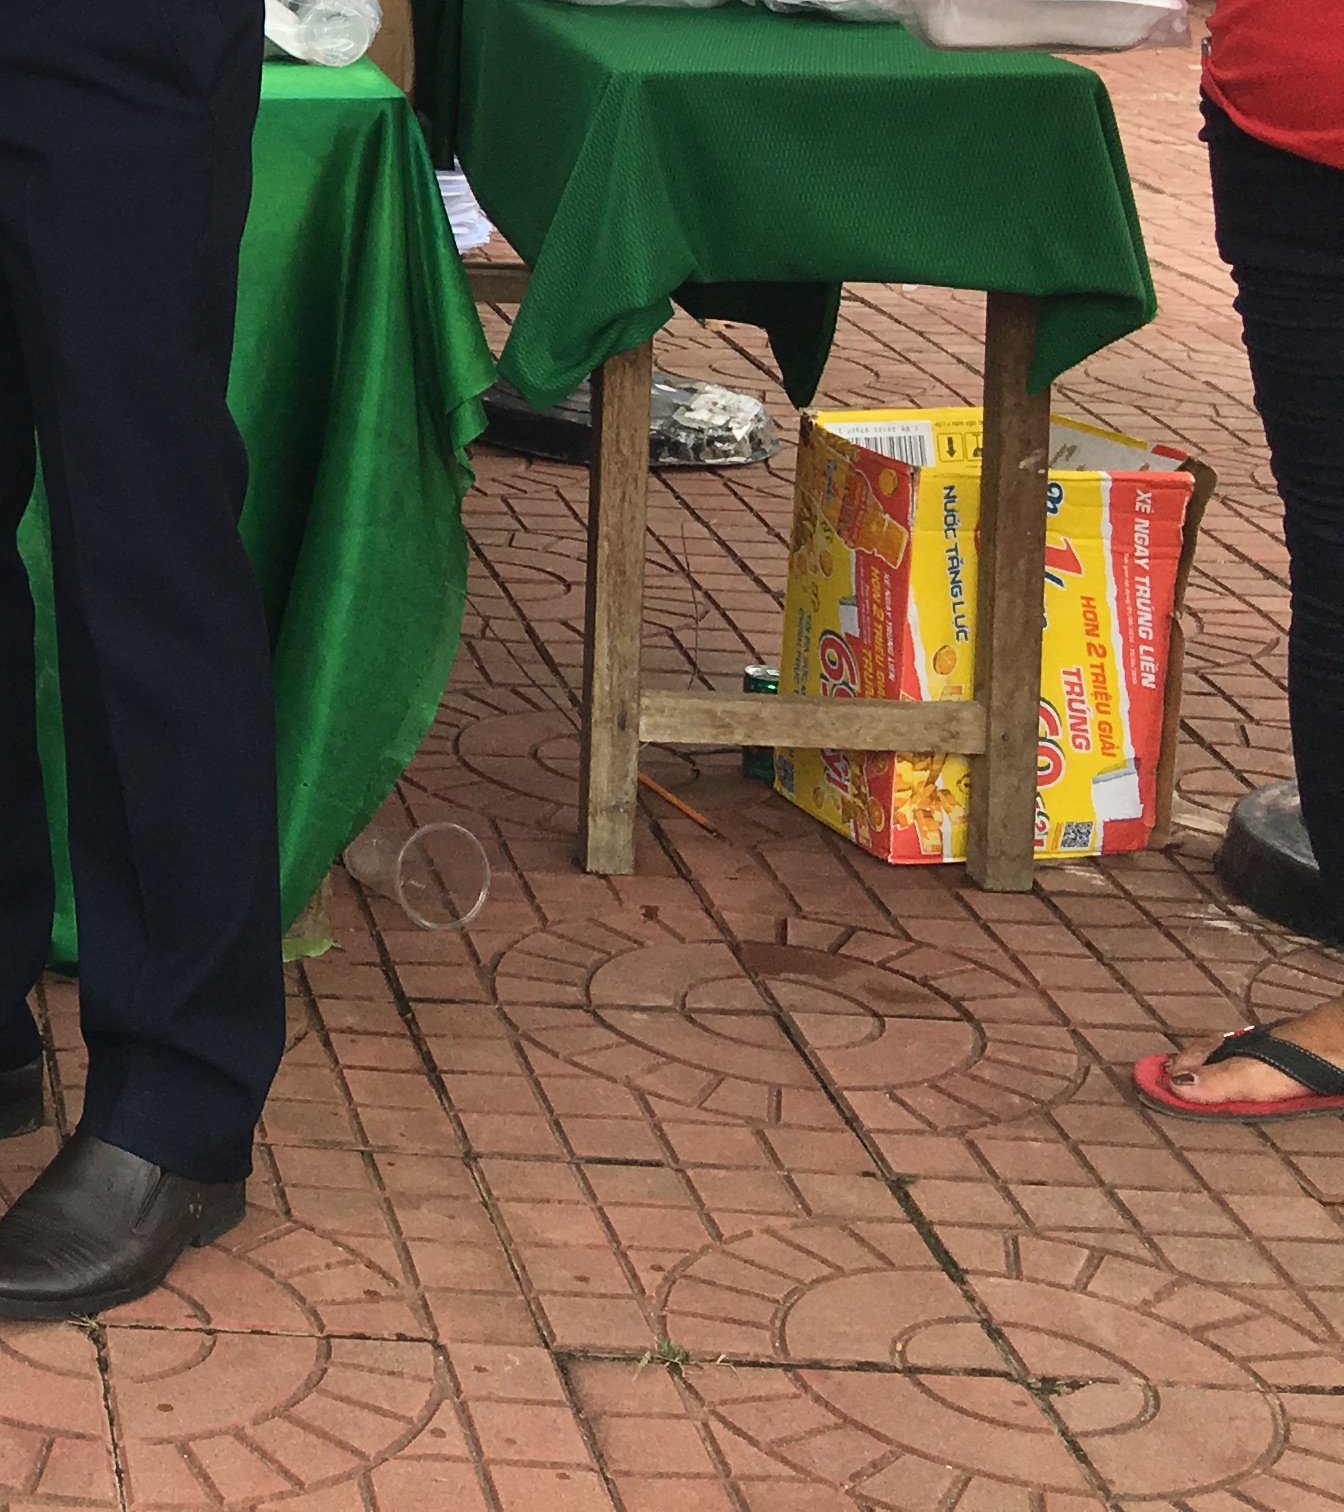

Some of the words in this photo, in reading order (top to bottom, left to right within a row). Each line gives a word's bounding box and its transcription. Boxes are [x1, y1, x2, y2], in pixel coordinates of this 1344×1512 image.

[943, 485, 962, 540] NƯỚC
[945, 542, 965, 599] TĂNG
[1133, 518, 1152, 571] NGAY
[873, 604, 885, 620] 2
[950, 600, 969, 642] LỰC
[1079, 595, 1099, 638] HƠN
[1135, 574, 1156, 640] TRÚNG
[1086, 642, 1108, 658] 2
[1062, 666, 1095, 752] TRÚNG
[1089, 661, 1112, 716] TRIỆU
[1096, 720, 1117, 758] GIẢI
